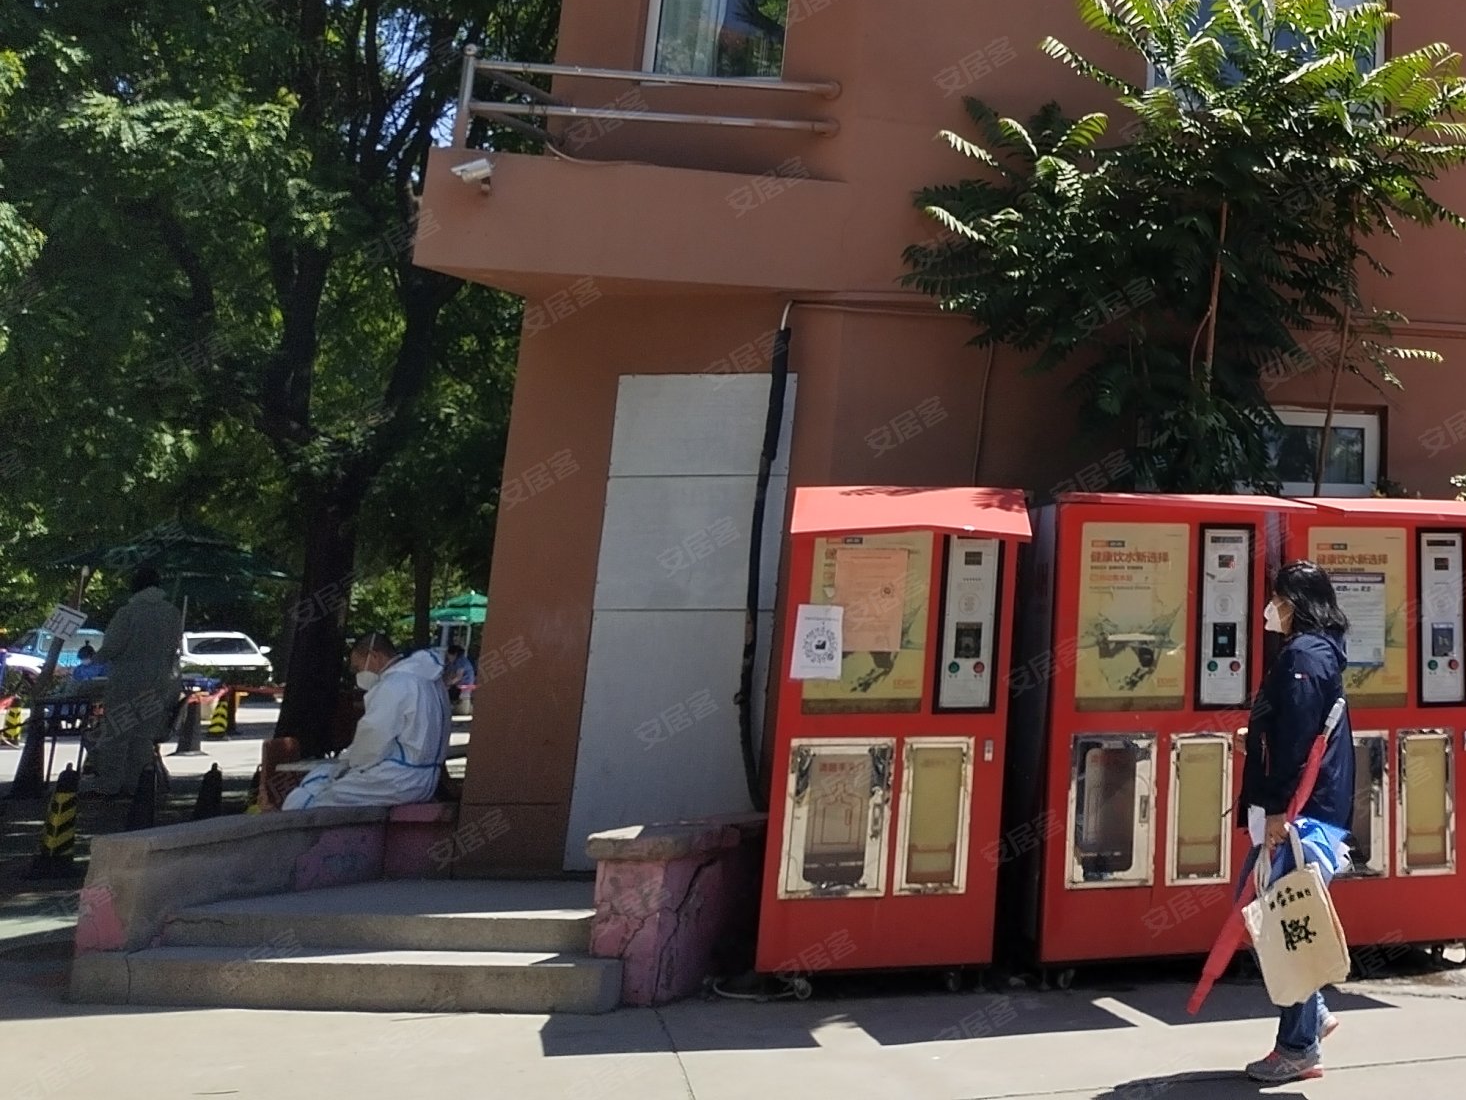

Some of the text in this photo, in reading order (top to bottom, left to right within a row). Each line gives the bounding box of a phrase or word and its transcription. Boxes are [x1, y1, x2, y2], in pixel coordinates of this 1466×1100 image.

[1090, 550, 1169, 564] 健康饮水新选择
[1316, 553, 1389, 565] 健康饮水新选择
